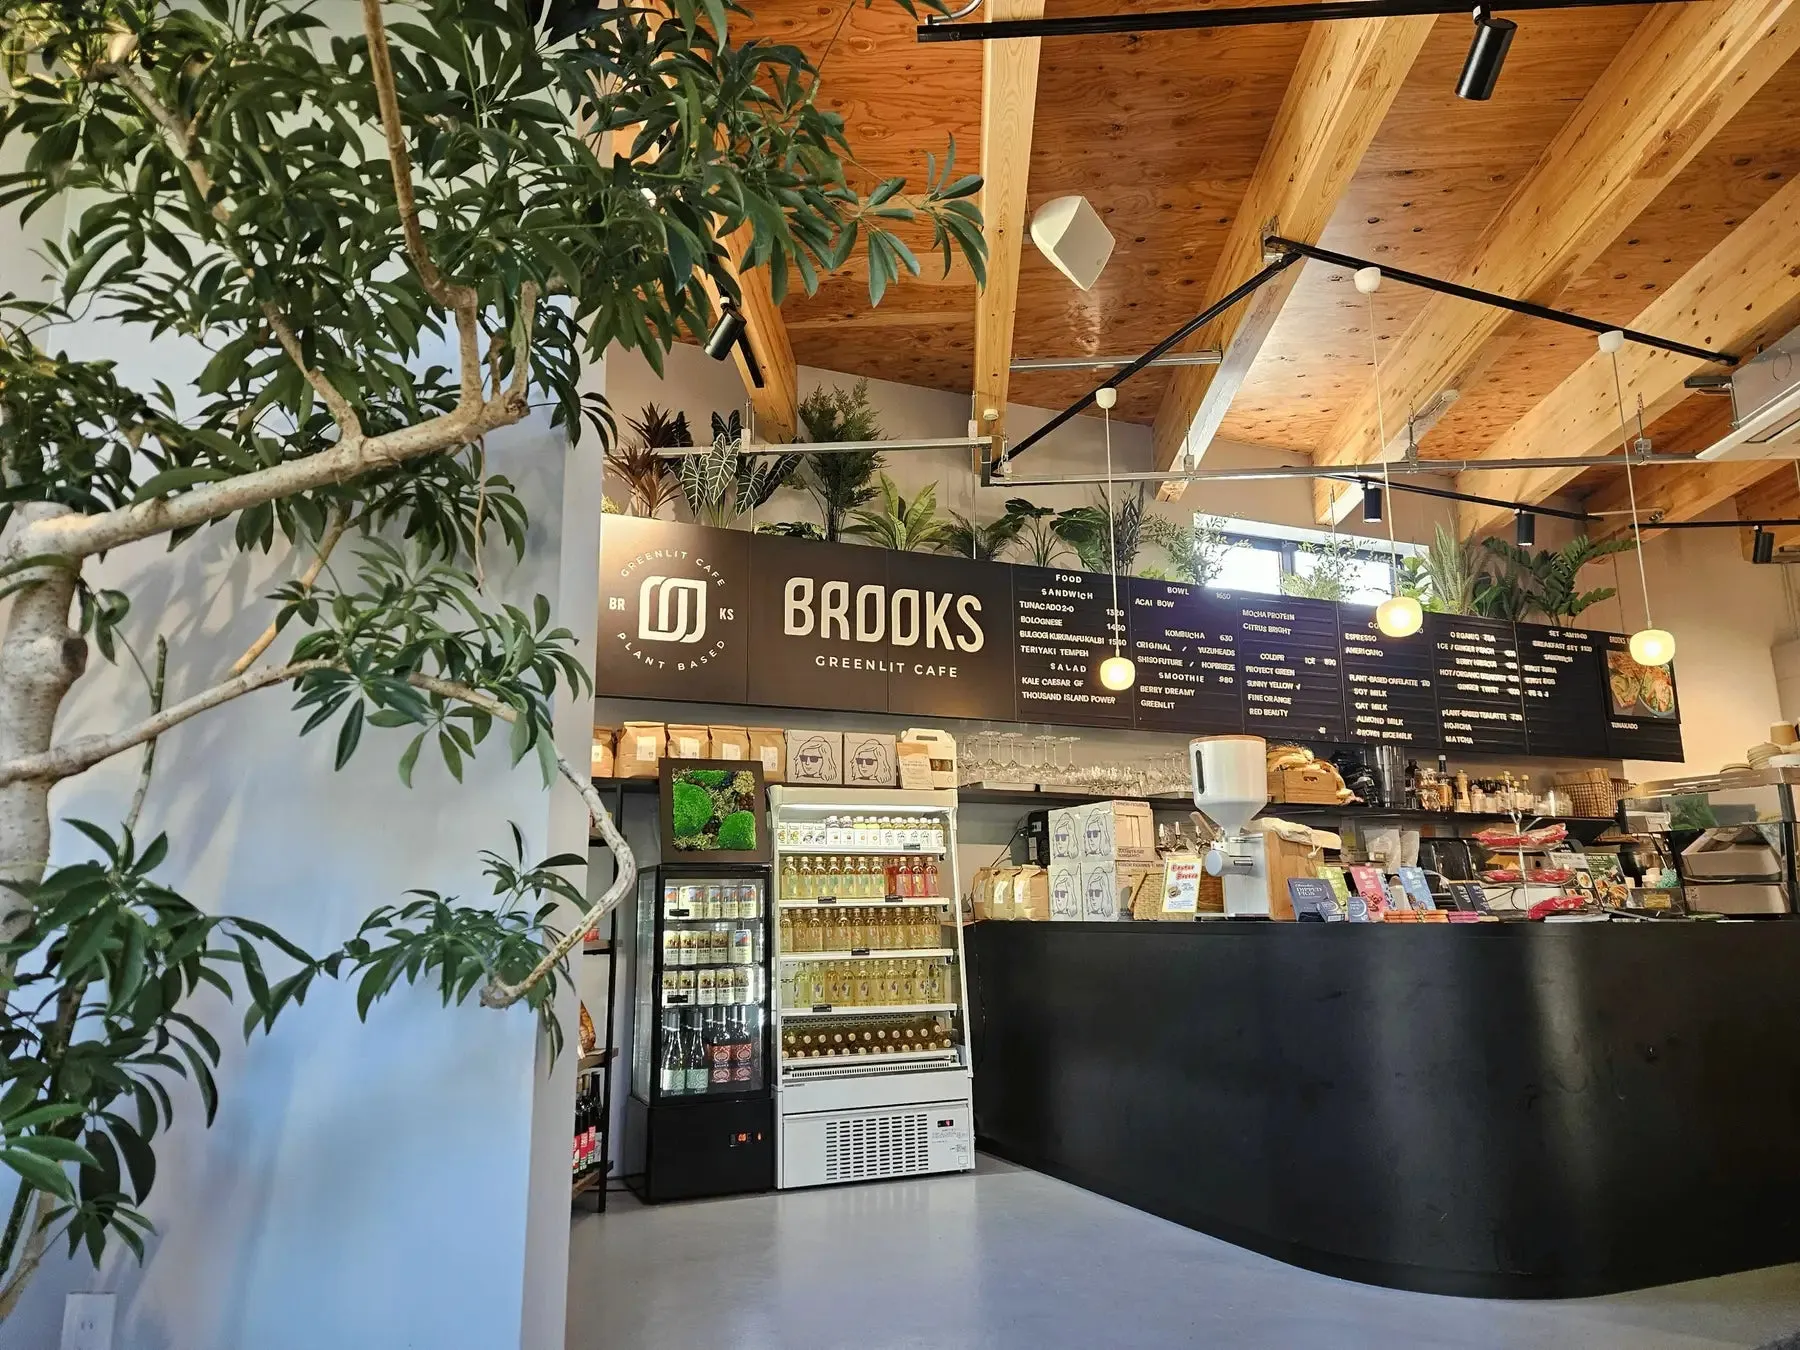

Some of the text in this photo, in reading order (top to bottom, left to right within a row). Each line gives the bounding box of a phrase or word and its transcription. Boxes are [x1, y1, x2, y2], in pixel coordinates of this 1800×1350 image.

[620, 549, 725, 587] GREENLIT CAFE
[1055, 574, 1082, 584] FOOD
[1041, 588, 1094, 600] SANDWICH
[1167, 586, 1189, 596] BOWL
[608, 597, 625, 611] BR
[719, 607, 734, 620] KS
[1135, 598, 1174, 608] ACAI BOW
[784, 576, 985, 653] BROOKS
[1242, 609, 1295, 621] MOCHA PROTEIN
[1020, 615, 1063, 627] BOLOGNESE
[1243, 622, 1291, 635] CITRUS BRIGHT
[1165, 629, 1233, 642] KOMBUCHA 630
[1344, 632, 1377, 642] ESPRESSO
[617, 632, 725, 671] PLANT BASED
[1020, 645, 1089, 657] TERIYAKI TEMPEH
[1136, 641, 1172, 651] ORIGINAL
[1345, 646, 1384, 657] AMERICANO
[815, 655, 958, 678] GREENLIT CAFE
[1137, 655, 1157, 664] SHISO
[1158, 657, 1183, 667] FUTURE
[1050, 662, 1087, 673] SALAD
[1245, 665, 1295, 676] PROTECT GREEN
[1021, 676, 1040, 685] KALE
[1041, 678, 1071, 687] CAESAR
[1158, 672, 1205, 683] SMOOTHIE
[1246, 679, 1294, 690] SUNNY YELLOW
[1140, 685, 1195, 697] BERRY DREAMY
[1353, 687, 1387, 697] SOY MILK
[1021, 691, 1116, 704] THOUSAND ISLAND POWER
[1247, 693, 1292, 705] FINE ORANGE
[1140, 699, 1175, 709] GREENLIT
[1354, 702, 1388, 711] OAT MILK
[1249, 707, 1288, 717] RED BEAUTY
[1356, 715, 1403, 726] ALMOND MILK
